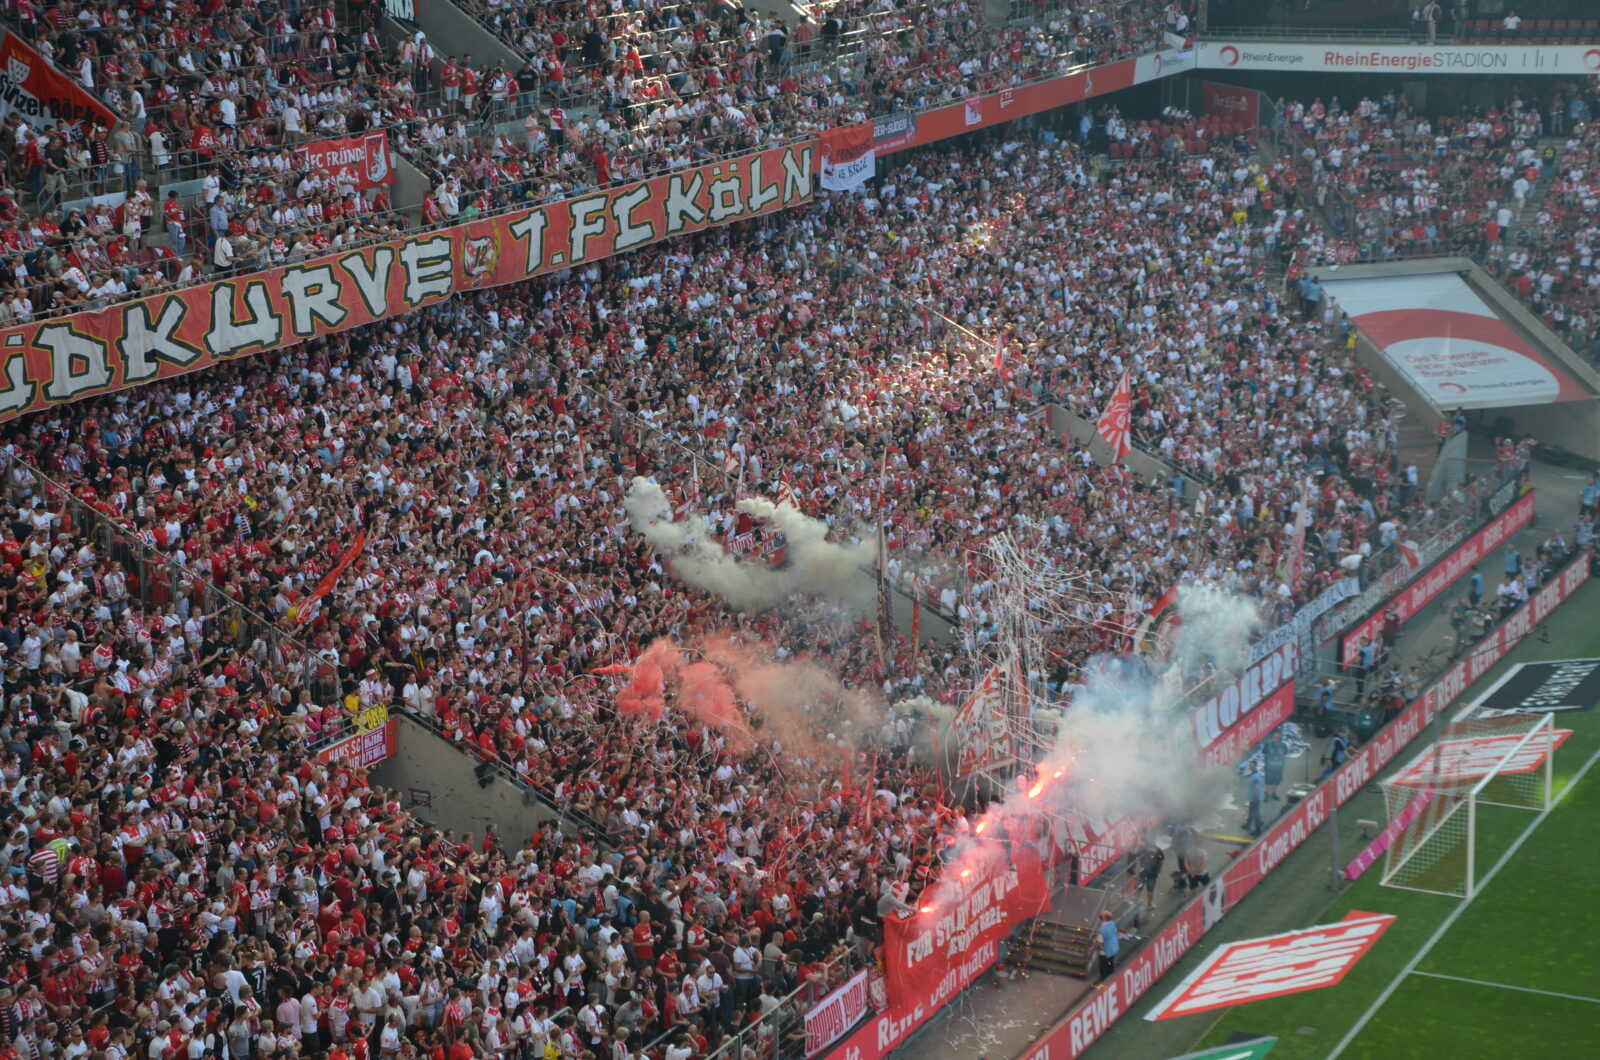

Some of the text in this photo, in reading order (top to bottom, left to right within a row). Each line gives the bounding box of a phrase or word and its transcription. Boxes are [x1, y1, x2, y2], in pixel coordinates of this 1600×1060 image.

[1242, 52, 1303, 64] RheinEnergie
[310, 153, 324, 168] FC
[664, 147, 812, 233] KÖLN
[1564, 553, 1590, 596] REWE
[1535, 577, 1561, 624] REWE
[1505, 604, 1531, 650] REWE
[1471, 631, 1500, 681] REWE
[1438, 662, 1466, 711] REWE
[1336, 711, 1419, 805] REWE Dein Markt
[1080, 831, 1116, 881] REWE
[1259, 832, 1289, 874] Come
[1290, 818, 1306, 847] on,
[1307, 791, 1325, 832] FC!
[1070, 921, 1190, 1057] REWE Dein Markt
